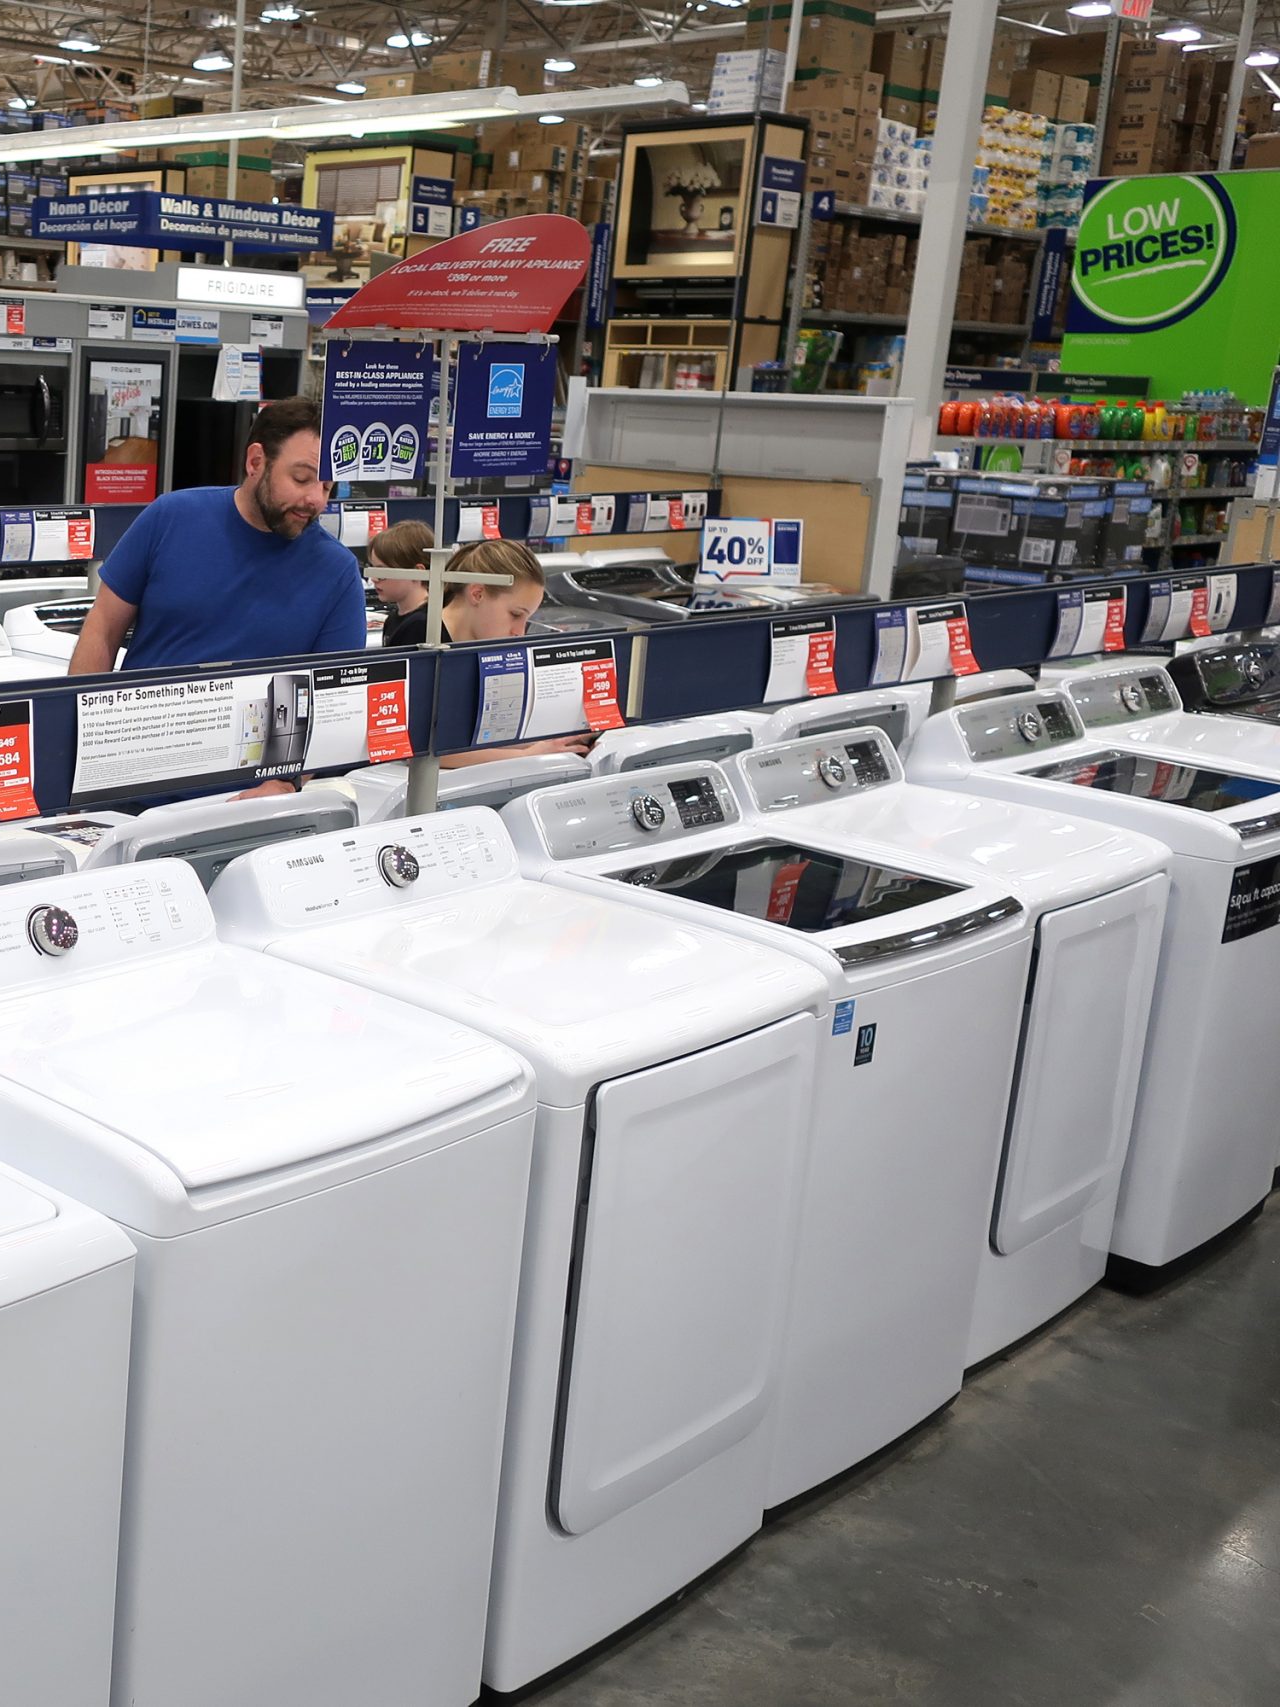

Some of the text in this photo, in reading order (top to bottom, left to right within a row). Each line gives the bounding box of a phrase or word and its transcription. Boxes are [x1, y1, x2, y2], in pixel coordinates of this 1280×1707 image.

[1134, 41, 1157, 50] CLR
[1127, 79, 1151, 87] CLR
[1121, 115, 1144, 124] CLR
[1115, 151, 1137, 160] CLR
[49, 196, 130, 216] Home Décor
[817, 196, 830, 211] 4
[160, 197, 321, 229] Walls & Windows Décor
[416, 213, 425, 226] 5
[466, 211, 476, 226] 5
[1106, 197, 1181, 240] LOW
[39, 218, 139, 233] Decoración del hogar
[160, 217, 319, 245] Decoración de paredes ventanas
[480, 237, 537, 253] FREE
[1080, 223, 1215, 277] PRICES!
[391, 259, 585, 275] LOCAL DELIVERY ON ANY APPLIANCE
[481, 274, 508, 282] more
[207, 280, 275, 296] FRIGIDAIRE
[176, 320, 218, 331] LOWES.COM
[336, 371, 424, 381] BEST-IN-CLASS APPLIANCES
[338, 437, 355, 446] RATED
[369, 435, 386, 443] RATED
[399, 436, 414, 445] RATED
[468, 431, 536, 440] SAVE ENERGY MONEY
[707, 536, 764, 565] 40%
[747, 557, 764, 566] OFF
[81, 679, 234, 708] Spring For Something New Event
[255, 763, 302, 778] SAMSUNG
[554, 797, 587, 810] SAMSUNG
[286, 854, 325, 869] SAMSUNG
[1242, 893, 1252, 904] cu
[860, 1027, 874, 1048] 10
